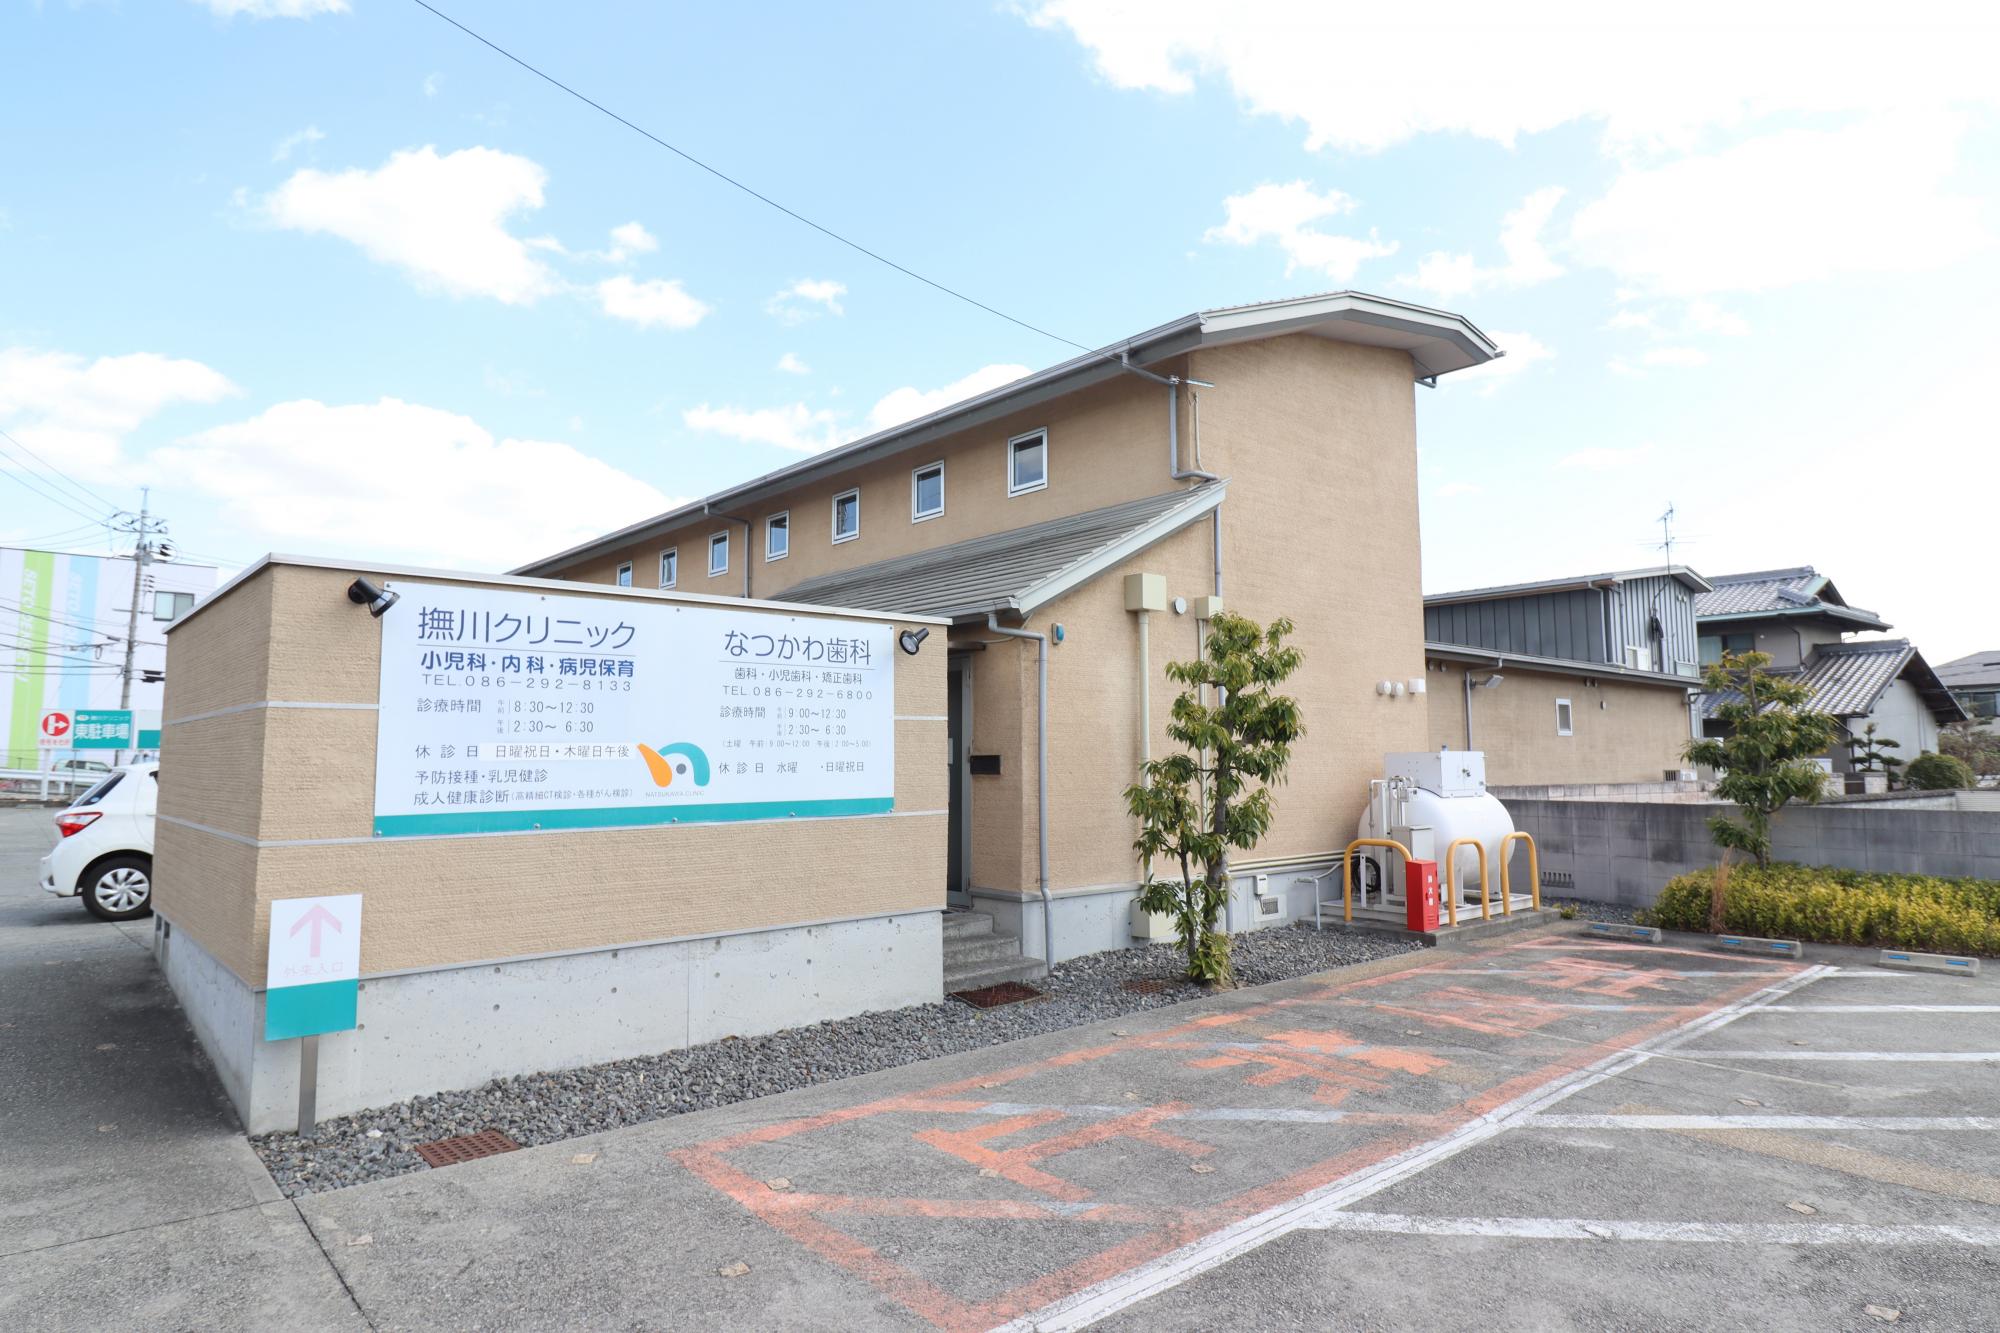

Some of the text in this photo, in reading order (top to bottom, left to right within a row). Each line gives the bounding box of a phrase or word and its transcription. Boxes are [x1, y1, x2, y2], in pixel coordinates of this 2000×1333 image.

[418, 606, 636, 650] 撫川クリニック
[724, 630, 872, 665] なつかわ歯科
[420, 650, 635, 678] 小児科・内科・病児保育
[734, 667, 863, 685] 歯科・小児歯科・矯正歯科
[416, 698, 481, 713] 診療時間
[720, 707, 766, 718] 診療時間
[495, 744, 630, 759] 日曜祝日・木曜日午後
[414, 768, 548, 785] 予防接種・乳児健診
